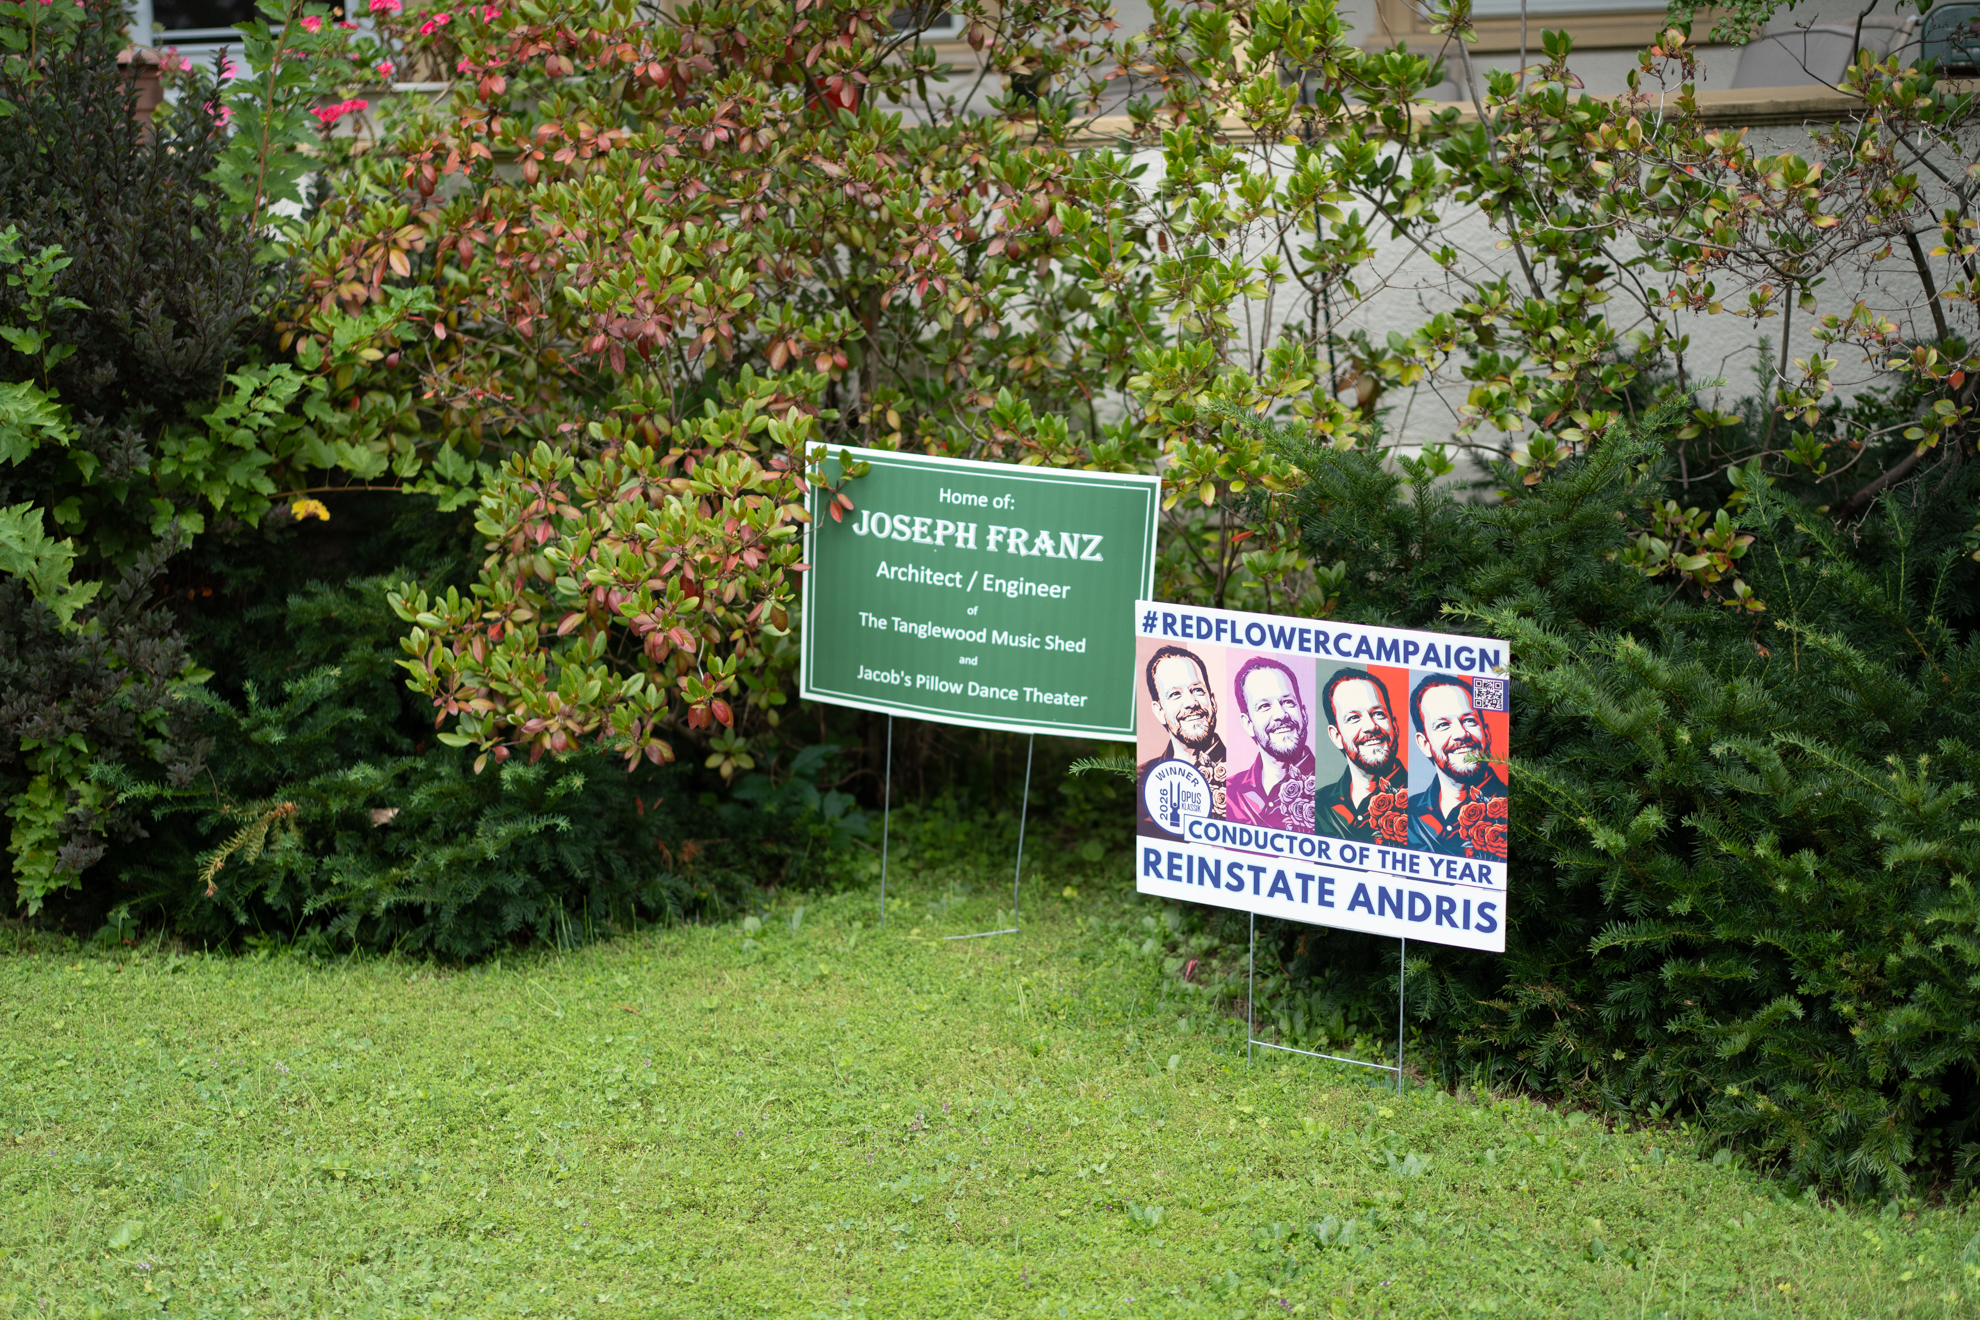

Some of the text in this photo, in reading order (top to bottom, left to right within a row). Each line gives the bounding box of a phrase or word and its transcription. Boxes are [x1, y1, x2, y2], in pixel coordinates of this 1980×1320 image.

[939, 488, 1015, 510] Home of:
[852, 510, 1104, 562] JOSEPH FRANZ
[876, 561, 1071, 599] Architect / Engineer
[967, 605, 979, 615] of
[859, 612, 1086, 653] The Tanglewood Music Shed
[1142, 611, 1500, 673] #REDFLOWERCAMPAIGN
[959, 655, 978, 666] and
[857, 665, 1088, 707] Jacob's Pillow Dance Theater
[1155, 767, 1199, 787] WINNER
[1160, 789, 1168, 820] 2026
[1182, 791, 1201, 804] OPUS
[1189, 821, 1493, 884] CONDUCTOR OF THE YEAR
[1144, 848, 1497, 933] REINSTATE ANDRIS
